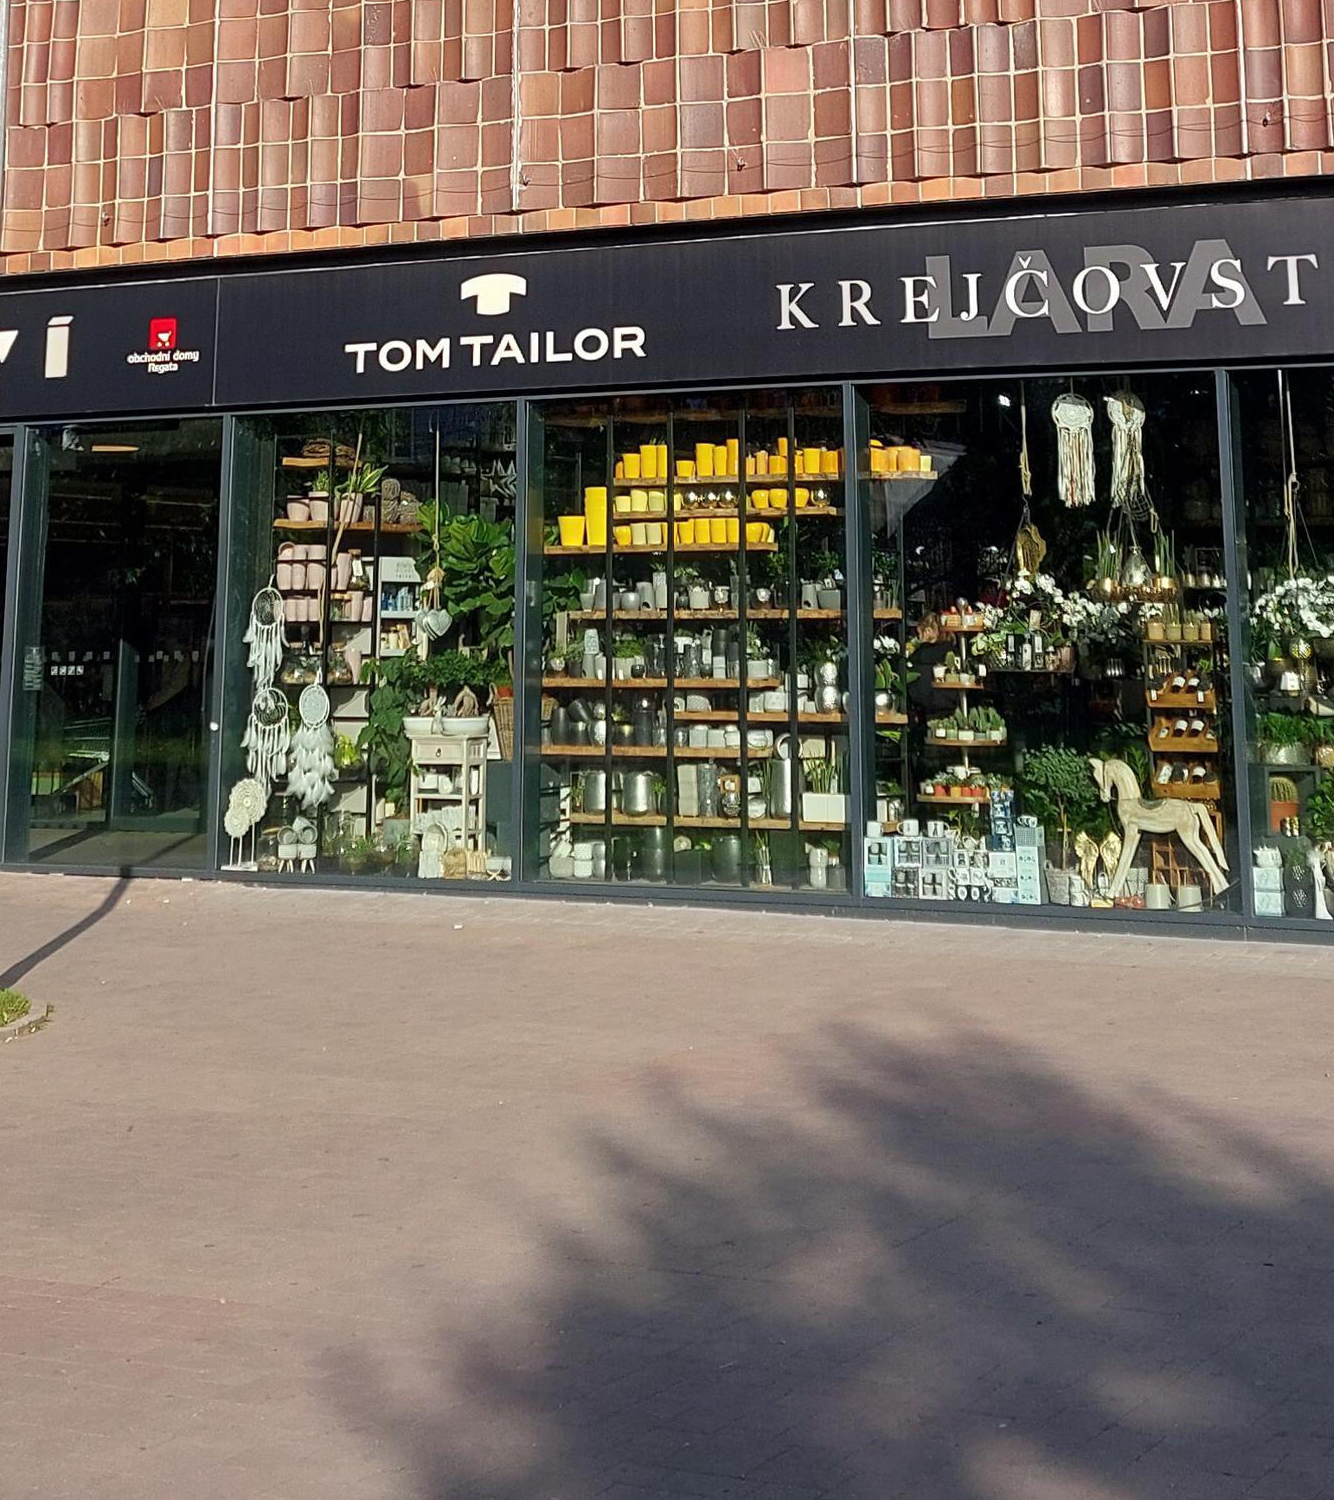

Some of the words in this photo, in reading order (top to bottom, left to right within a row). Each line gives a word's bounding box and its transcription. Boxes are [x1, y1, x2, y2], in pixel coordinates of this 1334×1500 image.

[925, 238, 1267, 340] LARA
[127, 351, 171, 364] obchodní
[173, 350, 200, 362] domy
[344, 337, 450, 374] TOM
[460, 326, 647, 367] TAILOR
[148, 363, 178, 374] Regata
